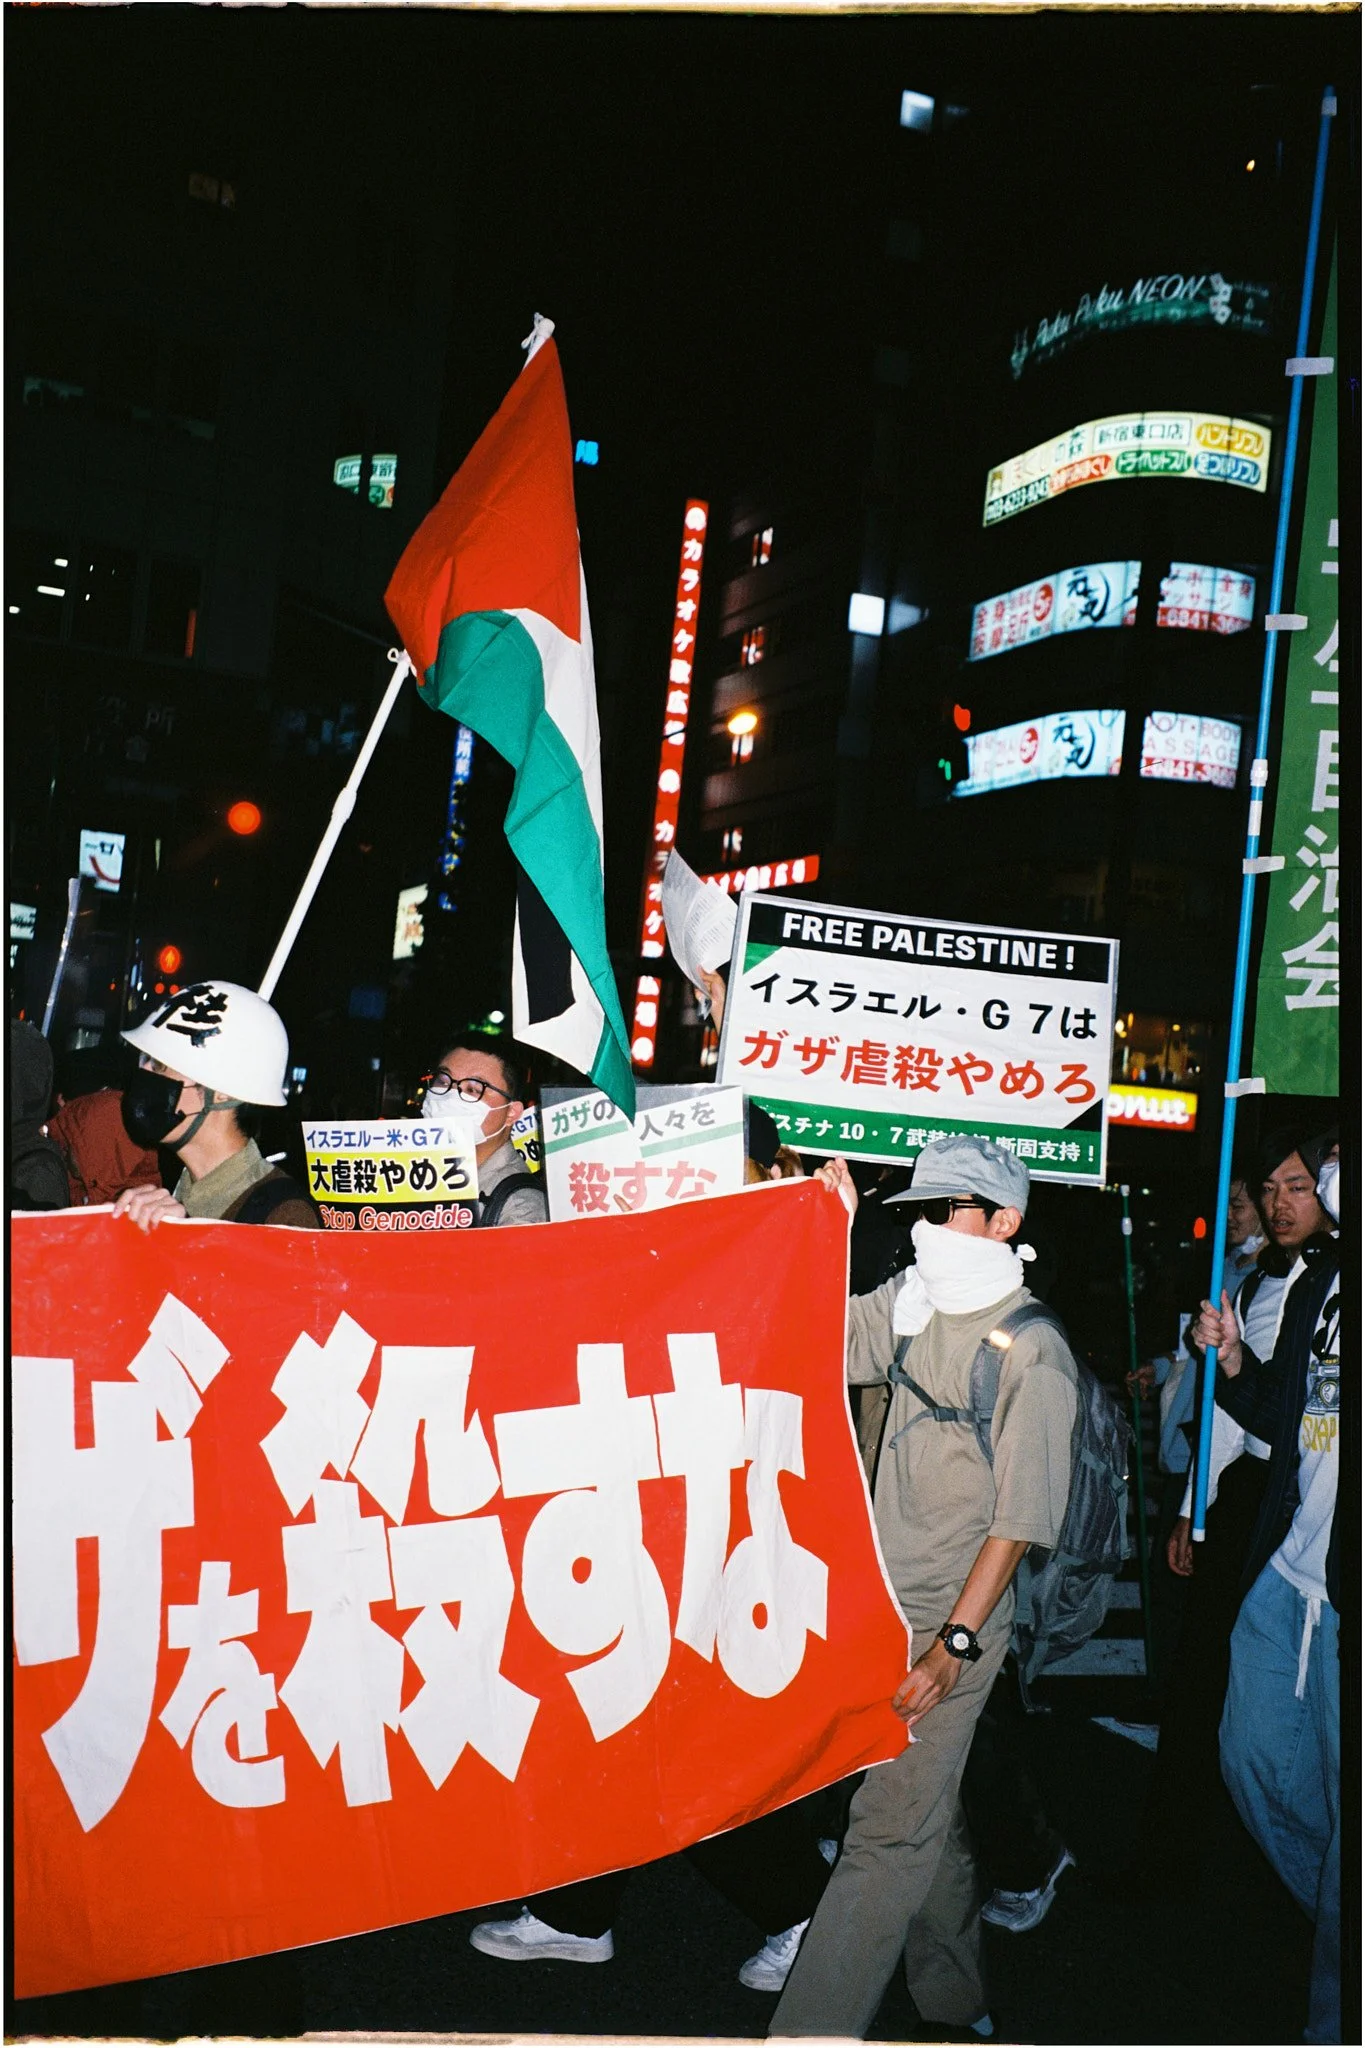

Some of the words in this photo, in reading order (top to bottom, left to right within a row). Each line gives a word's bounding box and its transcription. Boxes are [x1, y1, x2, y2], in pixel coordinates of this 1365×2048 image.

[1128, 273, 1206, 305] NEON
[781, 912, 864, 948] FREE
[738, 1029, 1096, 1104] ガザ虐殺やめろ
[552, 1099, 616, 1136] ガザの
[639, 1101, 716, 1141] 人々を
[310, 1156, 471, 1193] 大虐殺やめろ
[568, 1160, 718, 1213] 殺すな
[318, 1204, 356, 1231] Stop
[359, 1203, 474, 1231] Genocide
